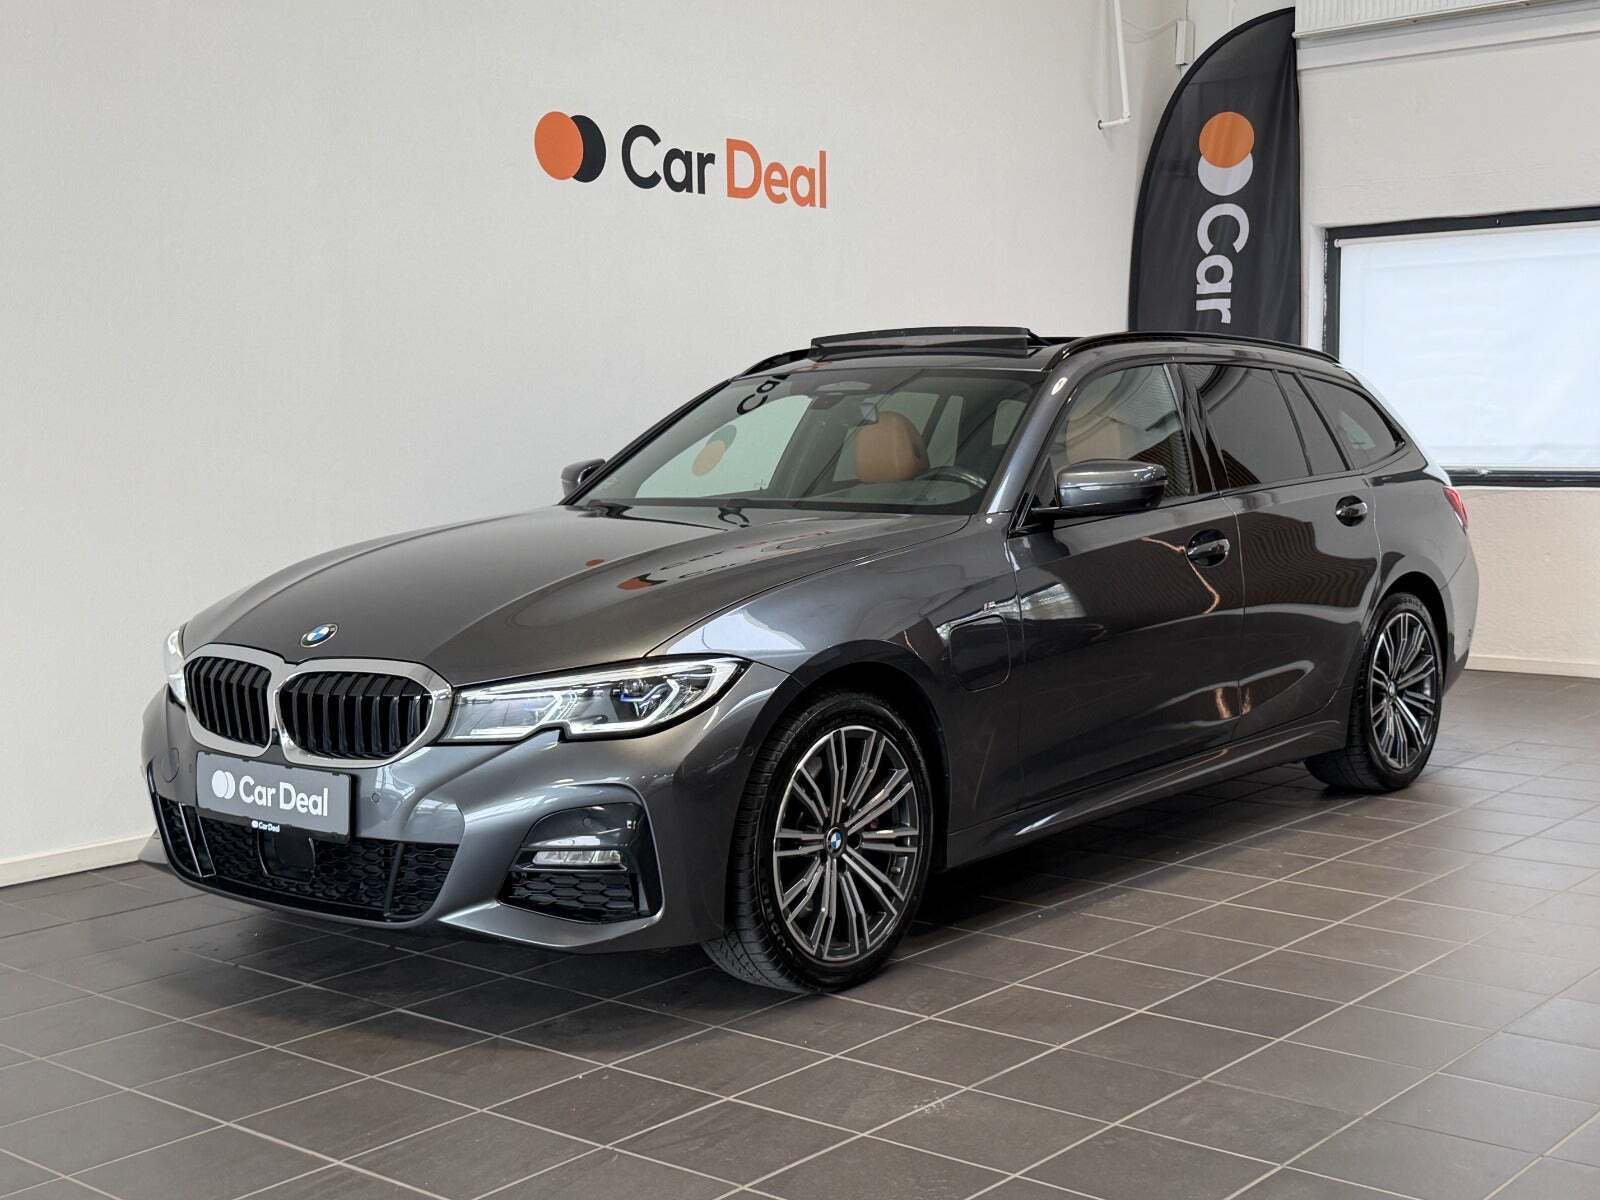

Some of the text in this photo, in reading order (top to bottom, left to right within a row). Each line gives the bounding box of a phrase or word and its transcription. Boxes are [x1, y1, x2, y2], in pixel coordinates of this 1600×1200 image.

[621, 124, 827, 209] Car Deal
[1196, 202, 1250, 324] Car
[239, 775, 328, 816] Car Deal
